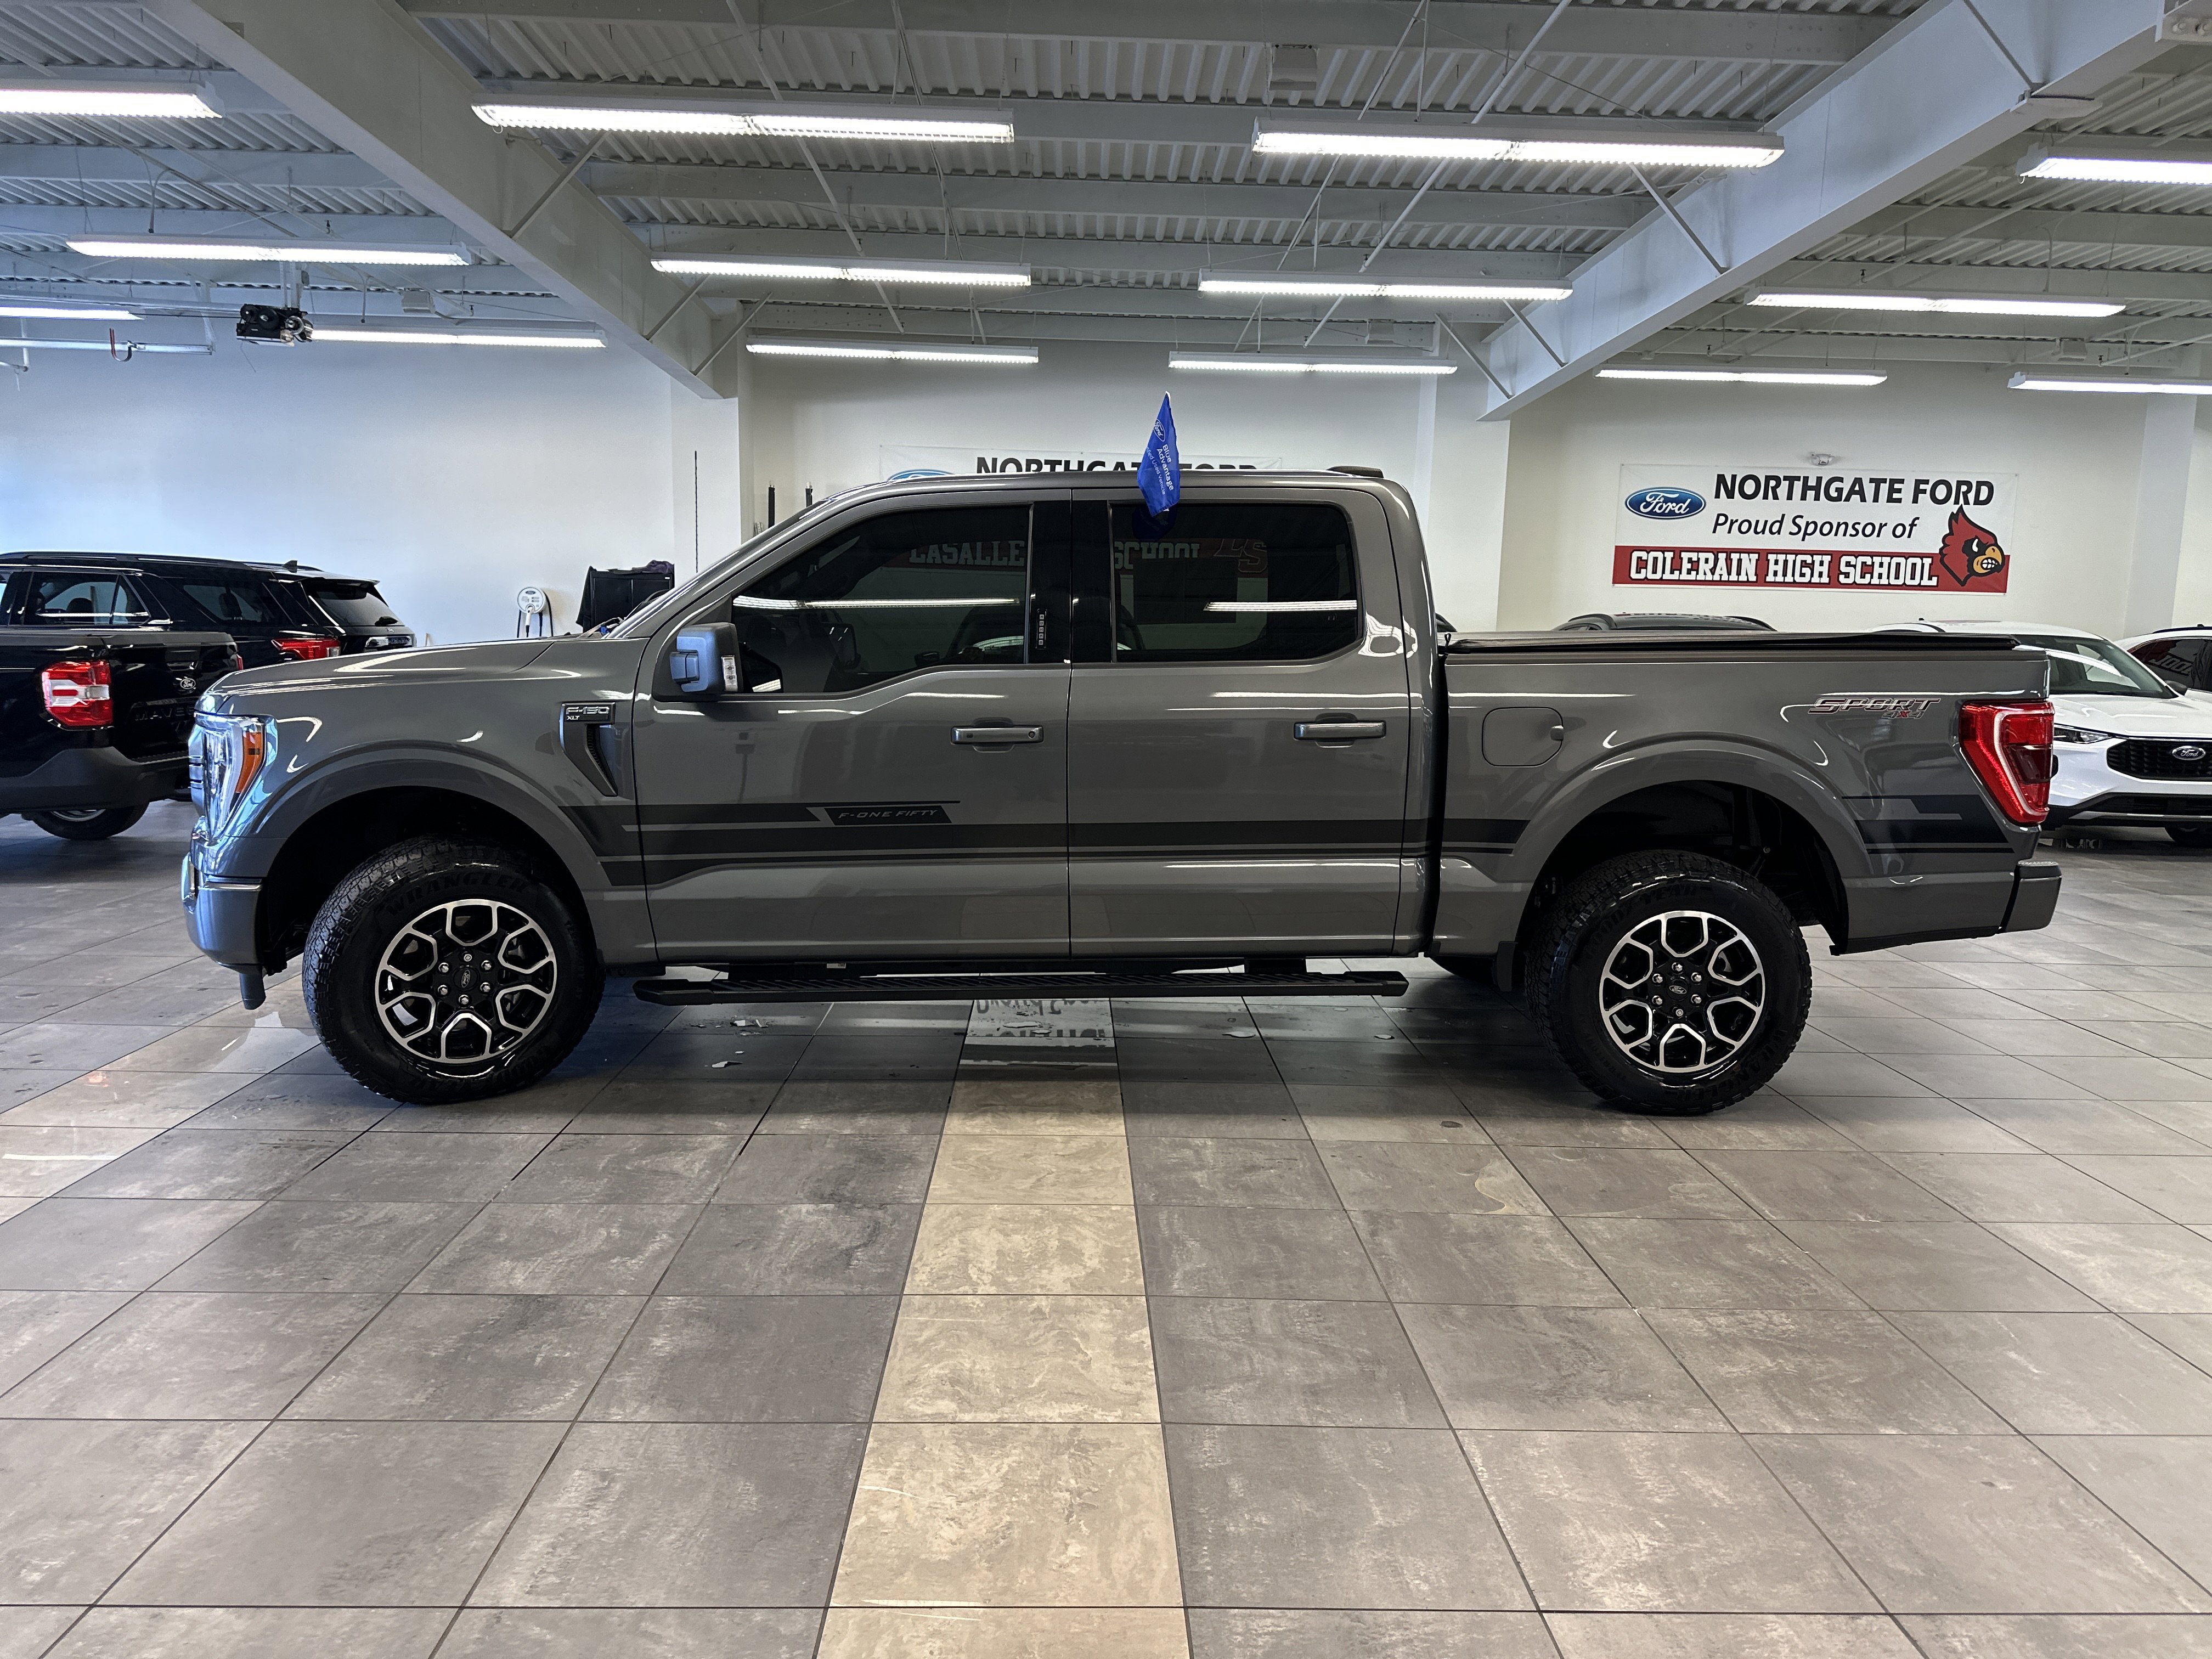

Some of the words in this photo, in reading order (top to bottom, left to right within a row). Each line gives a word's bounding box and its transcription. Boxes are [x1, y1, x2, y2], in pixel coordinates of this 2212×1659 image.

[1163, 444, 1172, 463] Blue
[1152, 459, 1161, 475] Used
[1156, 449, 1174, 491] Advantage
[1714, 473, 1904, 504] NORTHGATE
[1912, 479, 1994, 506] FORD
[1640, 492, 1689, 515] Ford
[1712, 513, 1784, 534] Proud
[1789, 517, 1887, 541] Sponsor
[1893, 517, 1920, 539] of
[909, 540, 1025, 567] LASALLE
[1629, 551, 1757, 582] COLERAIN
[1766, 554, 1830, 583] HIGH
[1838, 556, 1938, 586] SCHOOL
[566, 706, 610, 714] F-150
[1808, 697, 1941, 714] SPORT
[838, 811, 891, 819] F-ONE
[386, 871, 529, 916] WRANGLER
